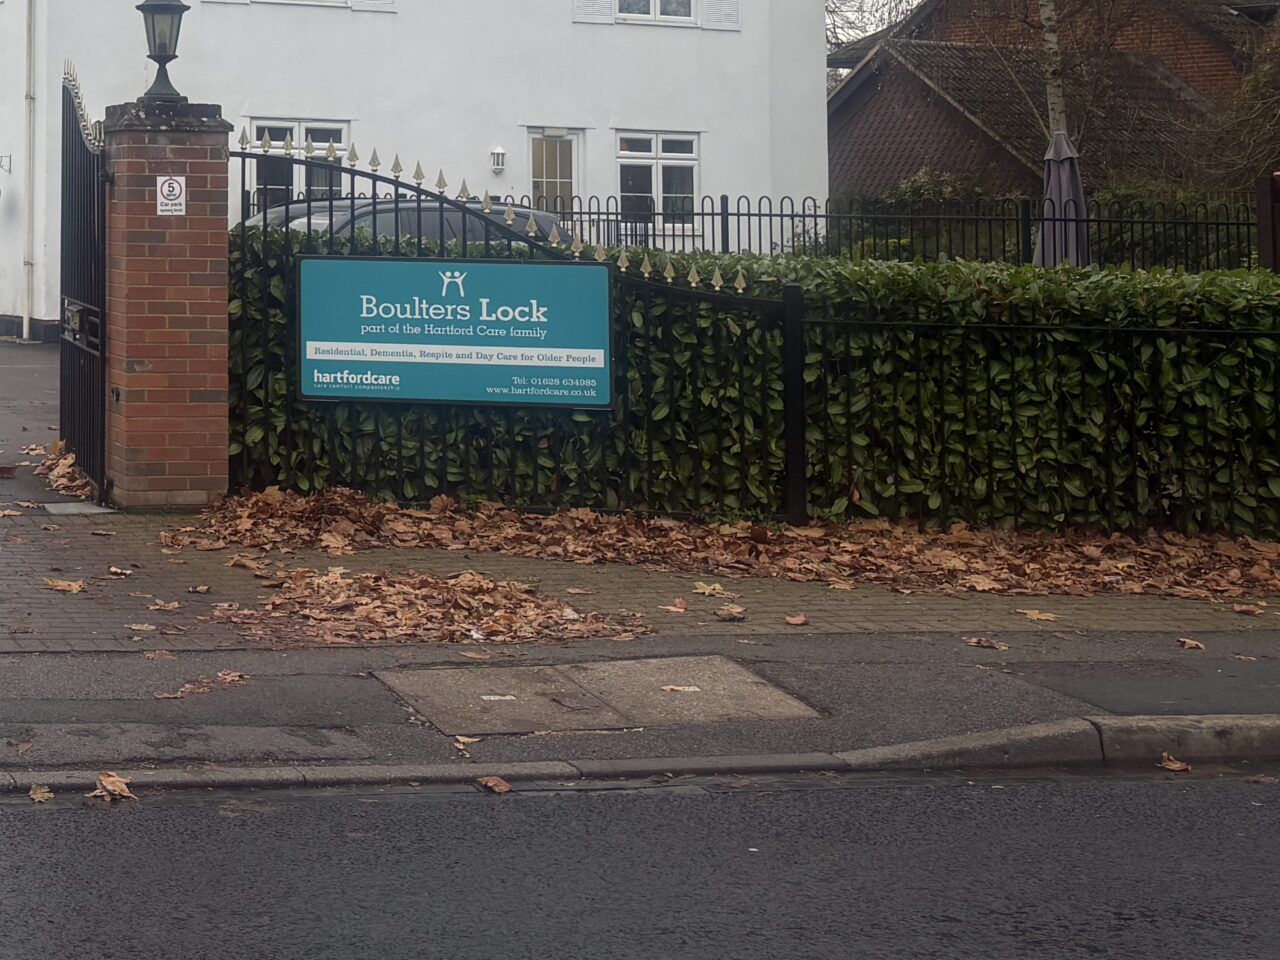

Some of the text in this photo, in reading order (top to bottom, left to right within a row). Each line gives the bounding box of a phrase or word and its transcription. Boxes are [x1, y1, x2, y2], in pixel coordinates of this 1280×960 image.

[168, 182, 175, 192] 5
[360, 295, 548, 322] Boulters Lock
[361, 324, 547, 339] part of the Hartford Care family
[314, 347, 368, 356] Residential,
[370, 349, 416, 358] Dementia,
[420, 350, 453, 360] Respite
[476, 352, 495, 361] Day
[521, 353, 534, 361] for
[537, 354, 563, 362] Older
[566, 355, 596, 364] People
[314, 369, 400, 384] hartfordcare
[486, 386, 596, 396] www.hartfordcare.co.uk
